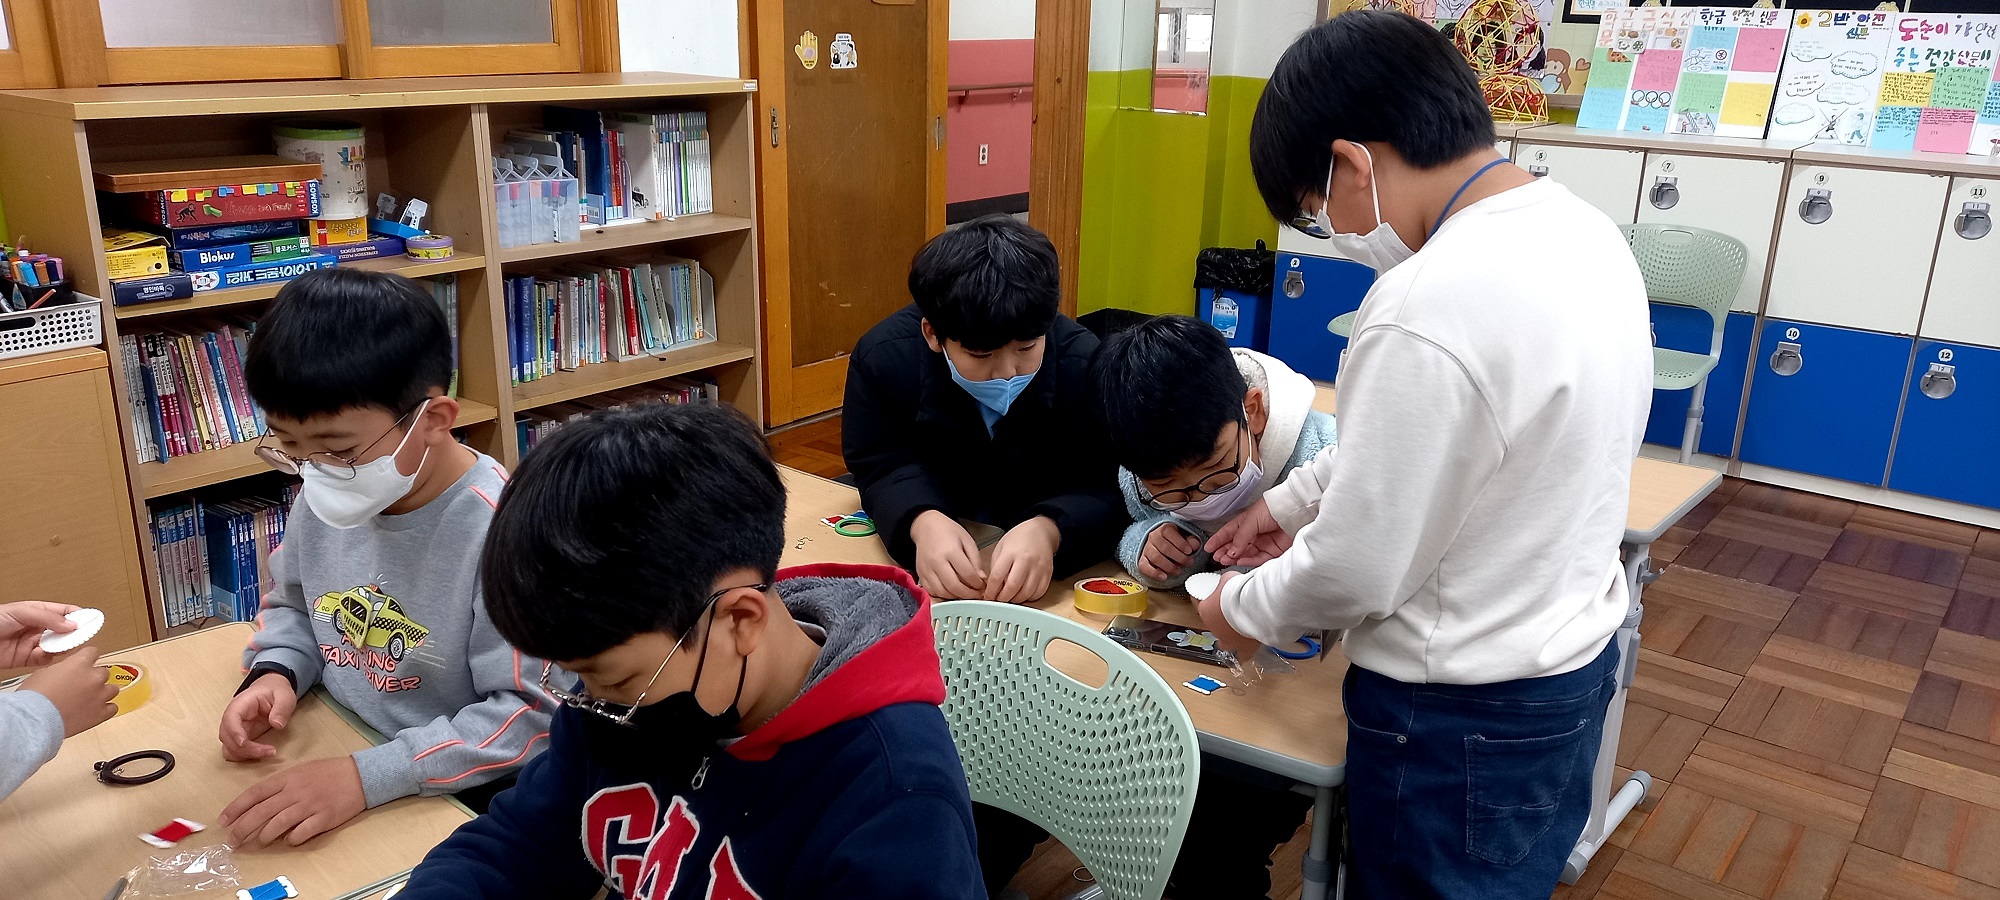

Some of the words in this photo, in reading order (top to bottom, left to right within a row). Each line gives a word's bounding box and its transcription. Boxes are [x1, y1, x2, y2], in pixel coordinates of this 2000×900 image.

[1700, 8, 1726, 26] 학급
[1760, 10, 1779, 26] 신문
[1856, 13, 1887, 27] 안전
[309, 182, 319, 215] KOSMOS
[1972, 188, 1983, 196] 11
[199, 250, 235, 264] Blokus
[319, 643, 360, 670] TAXI
